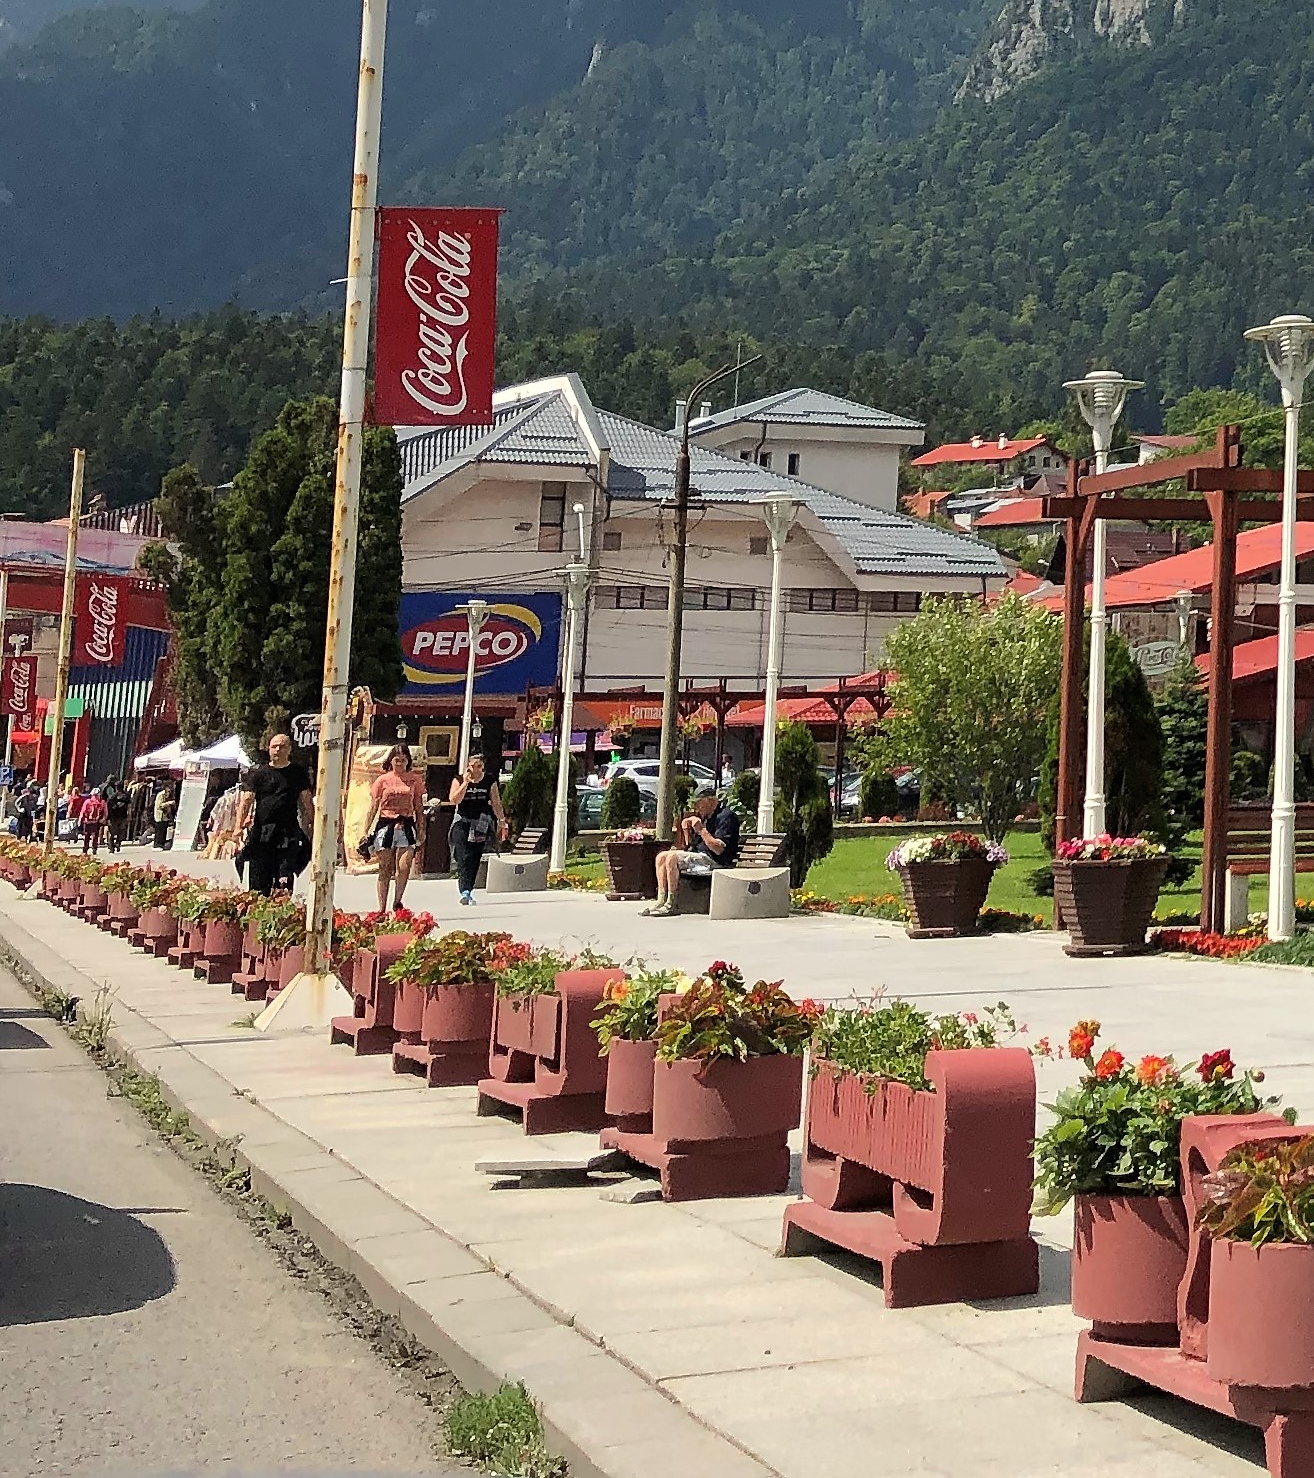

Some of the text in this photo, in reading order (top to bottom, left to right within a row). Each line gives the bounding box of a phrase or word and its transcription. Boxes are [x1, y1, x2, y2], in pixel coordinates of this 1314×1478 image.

[402, 218, 472, 415] Coca-Cola
[85, 582, 118, 661] Coca-Cola
[412, 631, 518, 656] PEPCO
